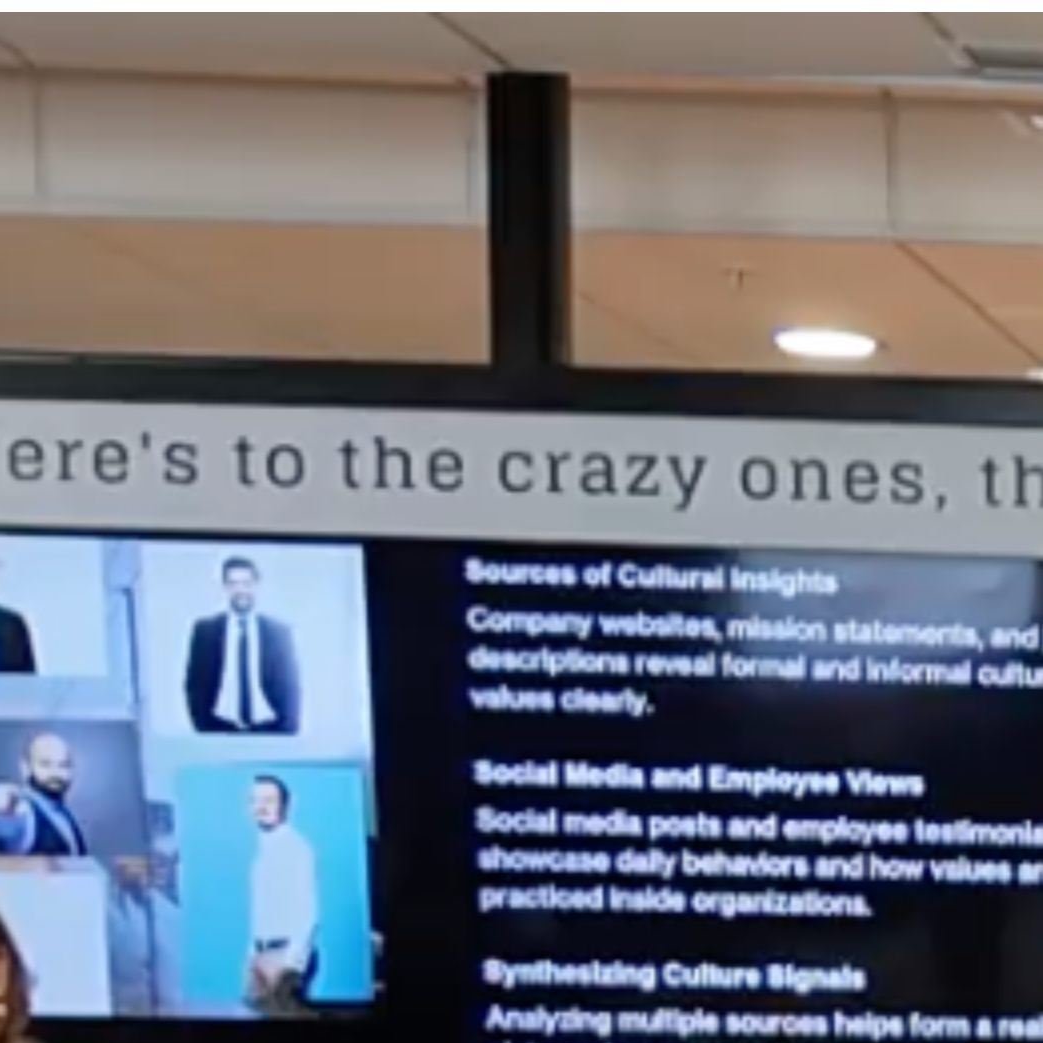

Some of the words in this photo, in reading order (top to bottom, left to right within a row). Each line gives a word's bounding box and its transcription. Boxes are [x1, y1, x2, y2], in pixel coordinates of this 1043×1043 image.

[233, 433, 306, 490] to
[338, 434, 466, 493] the
[495, 448, 707, 512] crazy
[739, 455, 948, 513] ones,
[464, 557, 575, 587] Sources
[583, 561, 611, 589] of
[618, 561, 723, 591] Cultural
[730, 567, 838, 598] Insights
[466, 604, 591, 640] Company
[599, 610, 722, 643] websites,
[728, 616, 826, 641] mission
[834, 620, 983, 647] statements,
[991, 625, 1039, 649] and
[468, 644, 628, 677] descriptions
[635, 651, 715, 677] reveal
[722, 651, 805, 680] formal
[813, 657, 860, 681] and
[867, 657, 971, 684] informal
[468, 683, 554, 712] values
[561, 687, 654, 718] clearly.
[473, 759, 556, 788] Social
[564, 760, 643, 790] Media
[651, 763, 701, 792] and
[710, 763, 839, 800] Employee
[846, 768, 925, 797] Views
[475, 804, 555, 835] Social
[564, 808, 642, 837] media
[649, 811, 721, 842] posts
[728, 812, 777, 841] and
[783, 815, 908, 846] employee
[477, 844, 609, 874] showcase
[617, 847, 675, 880] daily
[682, 848, 807, 880] behaviors
[815, 849, 864, 881] and
[871, 852, 924, 881] how
[930, 855, 1011, 885] values
[479, 883, 603, 913] practiced
[610, 884, 684, 913] inside
[692, 888, 872, 920] organizations.
[483, 957, 656, 993] Synthesizing
[663, 960, 761, 990] Culture
[766, 963, 867, 996] Signals
[485, 1003, 612, 1038] Analyzing
[619, 1007, 718, 1039] multiple
[726, 1012, 828, 1037] sources
[835, 1010, 903, 1042] helps
[910, 1011, 969, 1040] form
[976, 1016, 992, 1040] a
